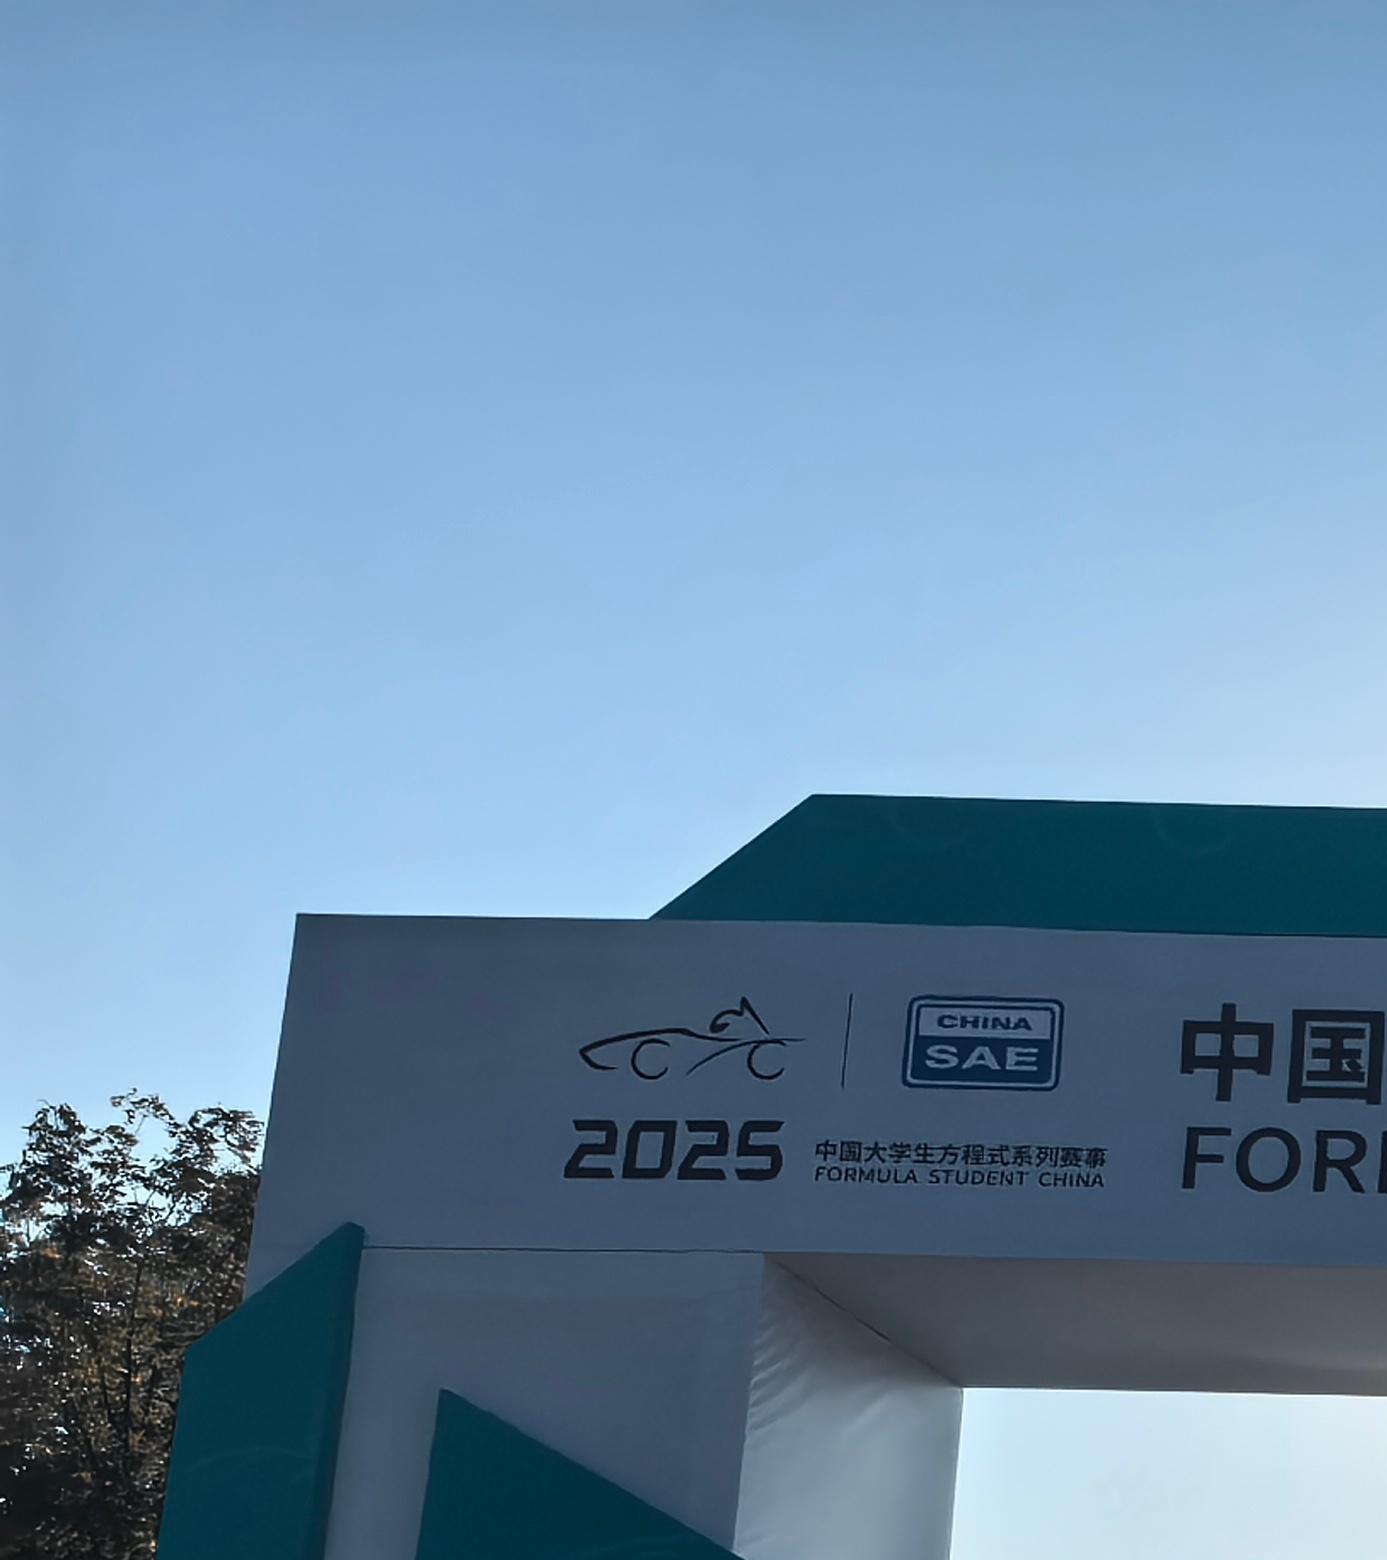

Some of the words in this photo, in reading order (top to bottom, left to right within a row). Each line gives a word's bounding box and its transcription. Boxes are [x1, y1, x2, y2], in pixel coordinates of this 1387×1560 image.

[937, 1013, 1033, 1032] CHINA
[924, 1045, 1039, 1072] SAE
[563, 1119, 786, 1181] 2025
[814, 1140, 1109, 1170] 中国大学生方程式系列赛事
[814, 1166, 919, 1185] FORMULA
[928, 1168, 1029, 1188] STUDENT
[1038, 1171, 1105, 1189] CHINA
